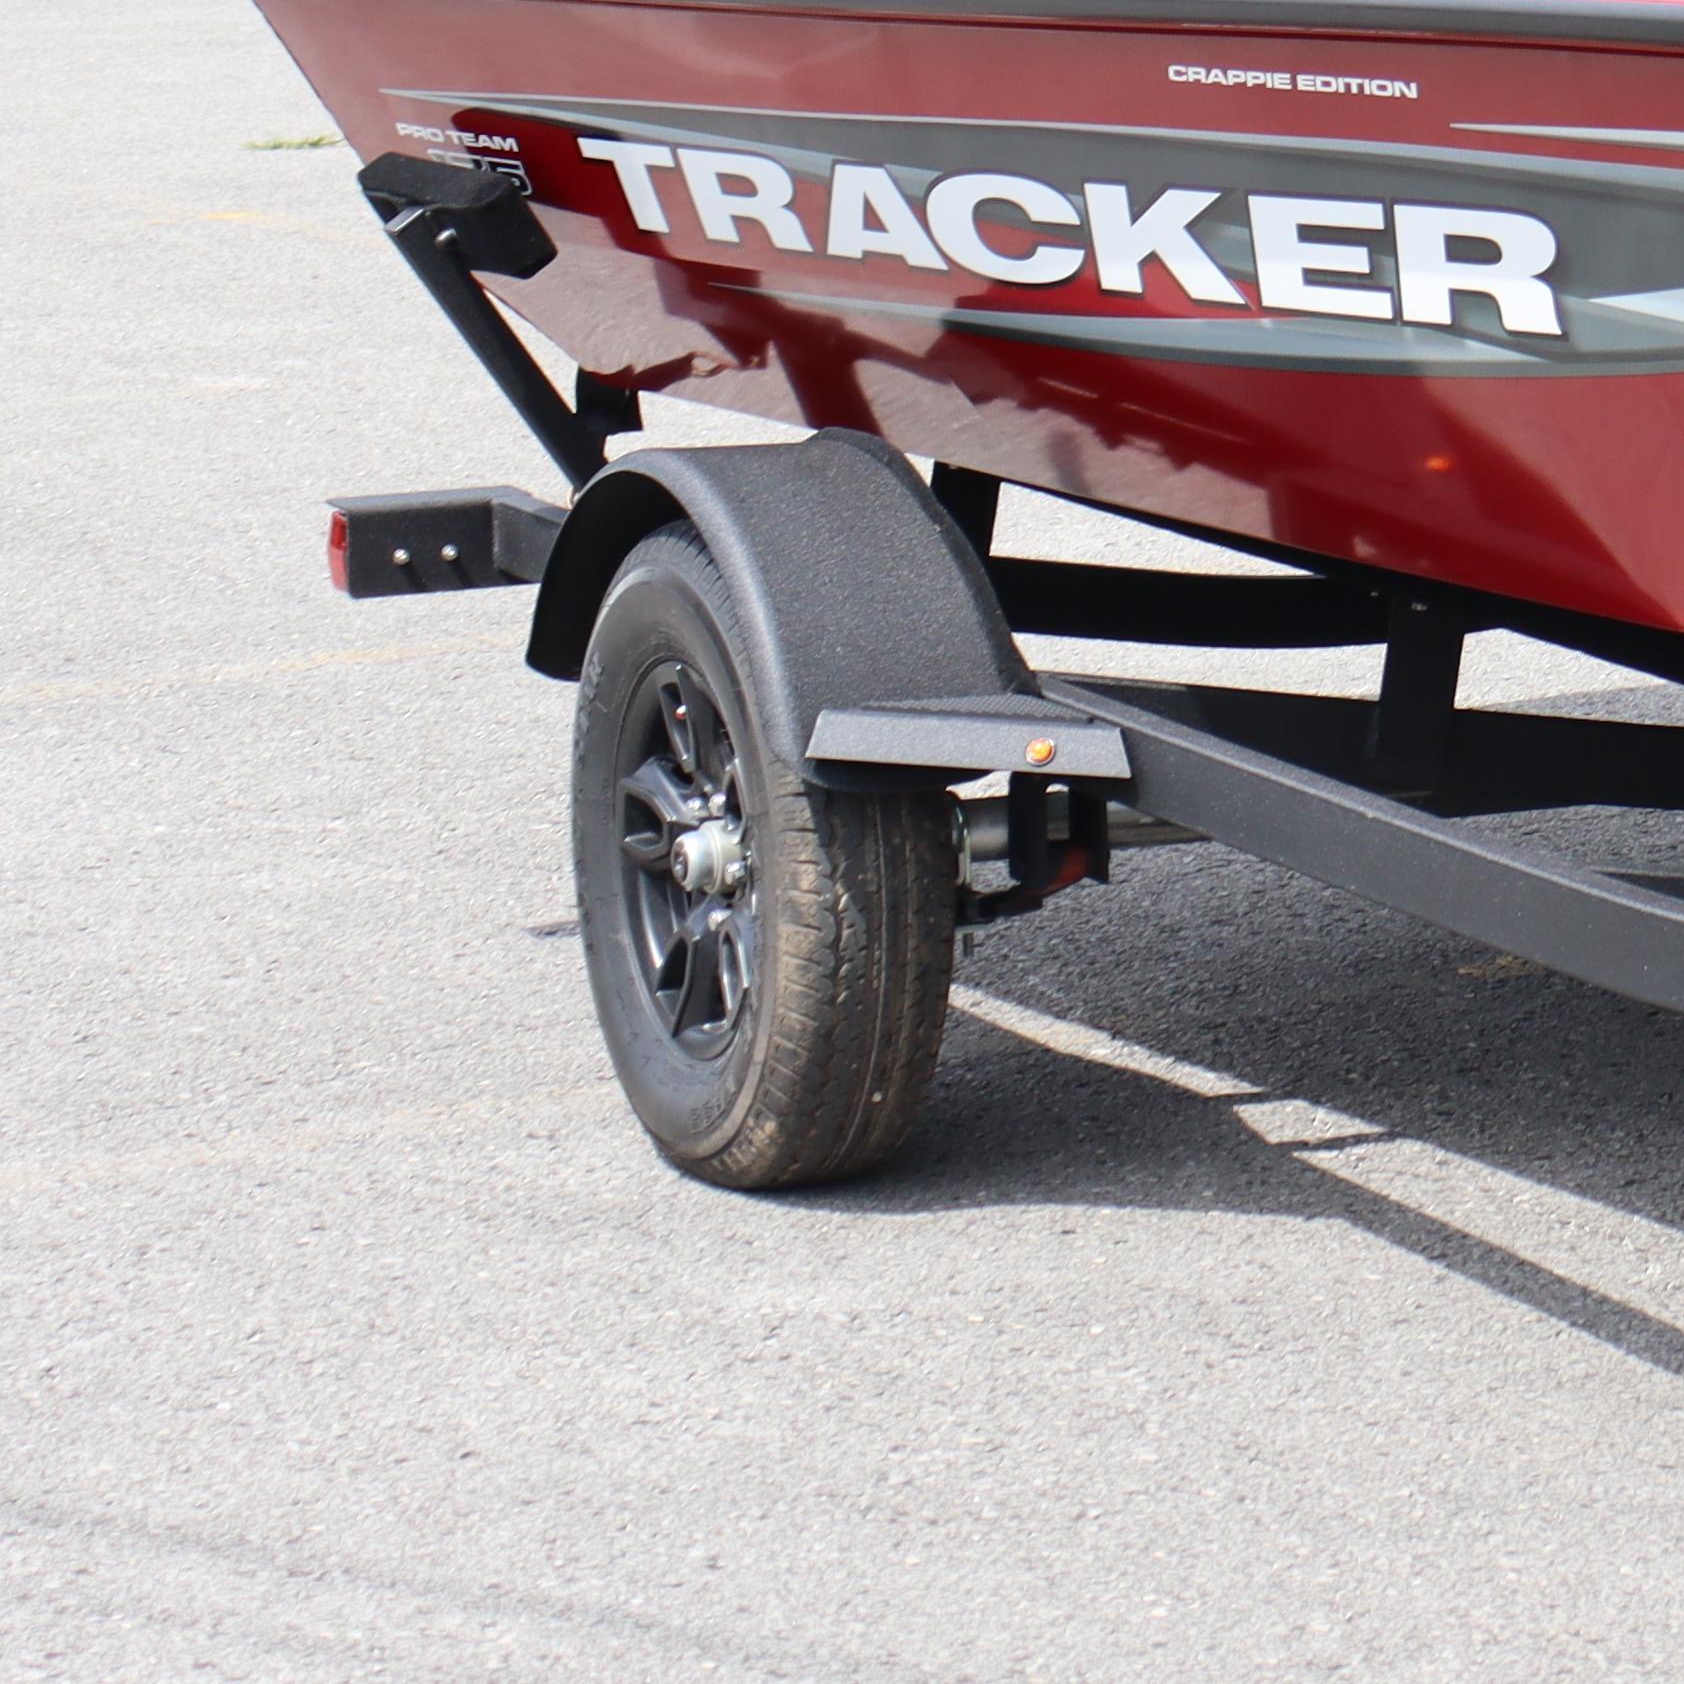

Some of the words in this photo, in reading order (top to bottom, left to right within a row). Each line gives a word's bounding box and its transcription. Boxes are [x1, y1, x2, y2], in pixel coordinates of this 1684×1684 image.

[1168, 65, 1293, 90] CRAPPIE
[1296, 74, 1419, 99] EDITION
[394, 122, 446, 143] PRO
[445, 130, 520, 153] TEAM
[576, 137, 1567, 337] TRACKER
